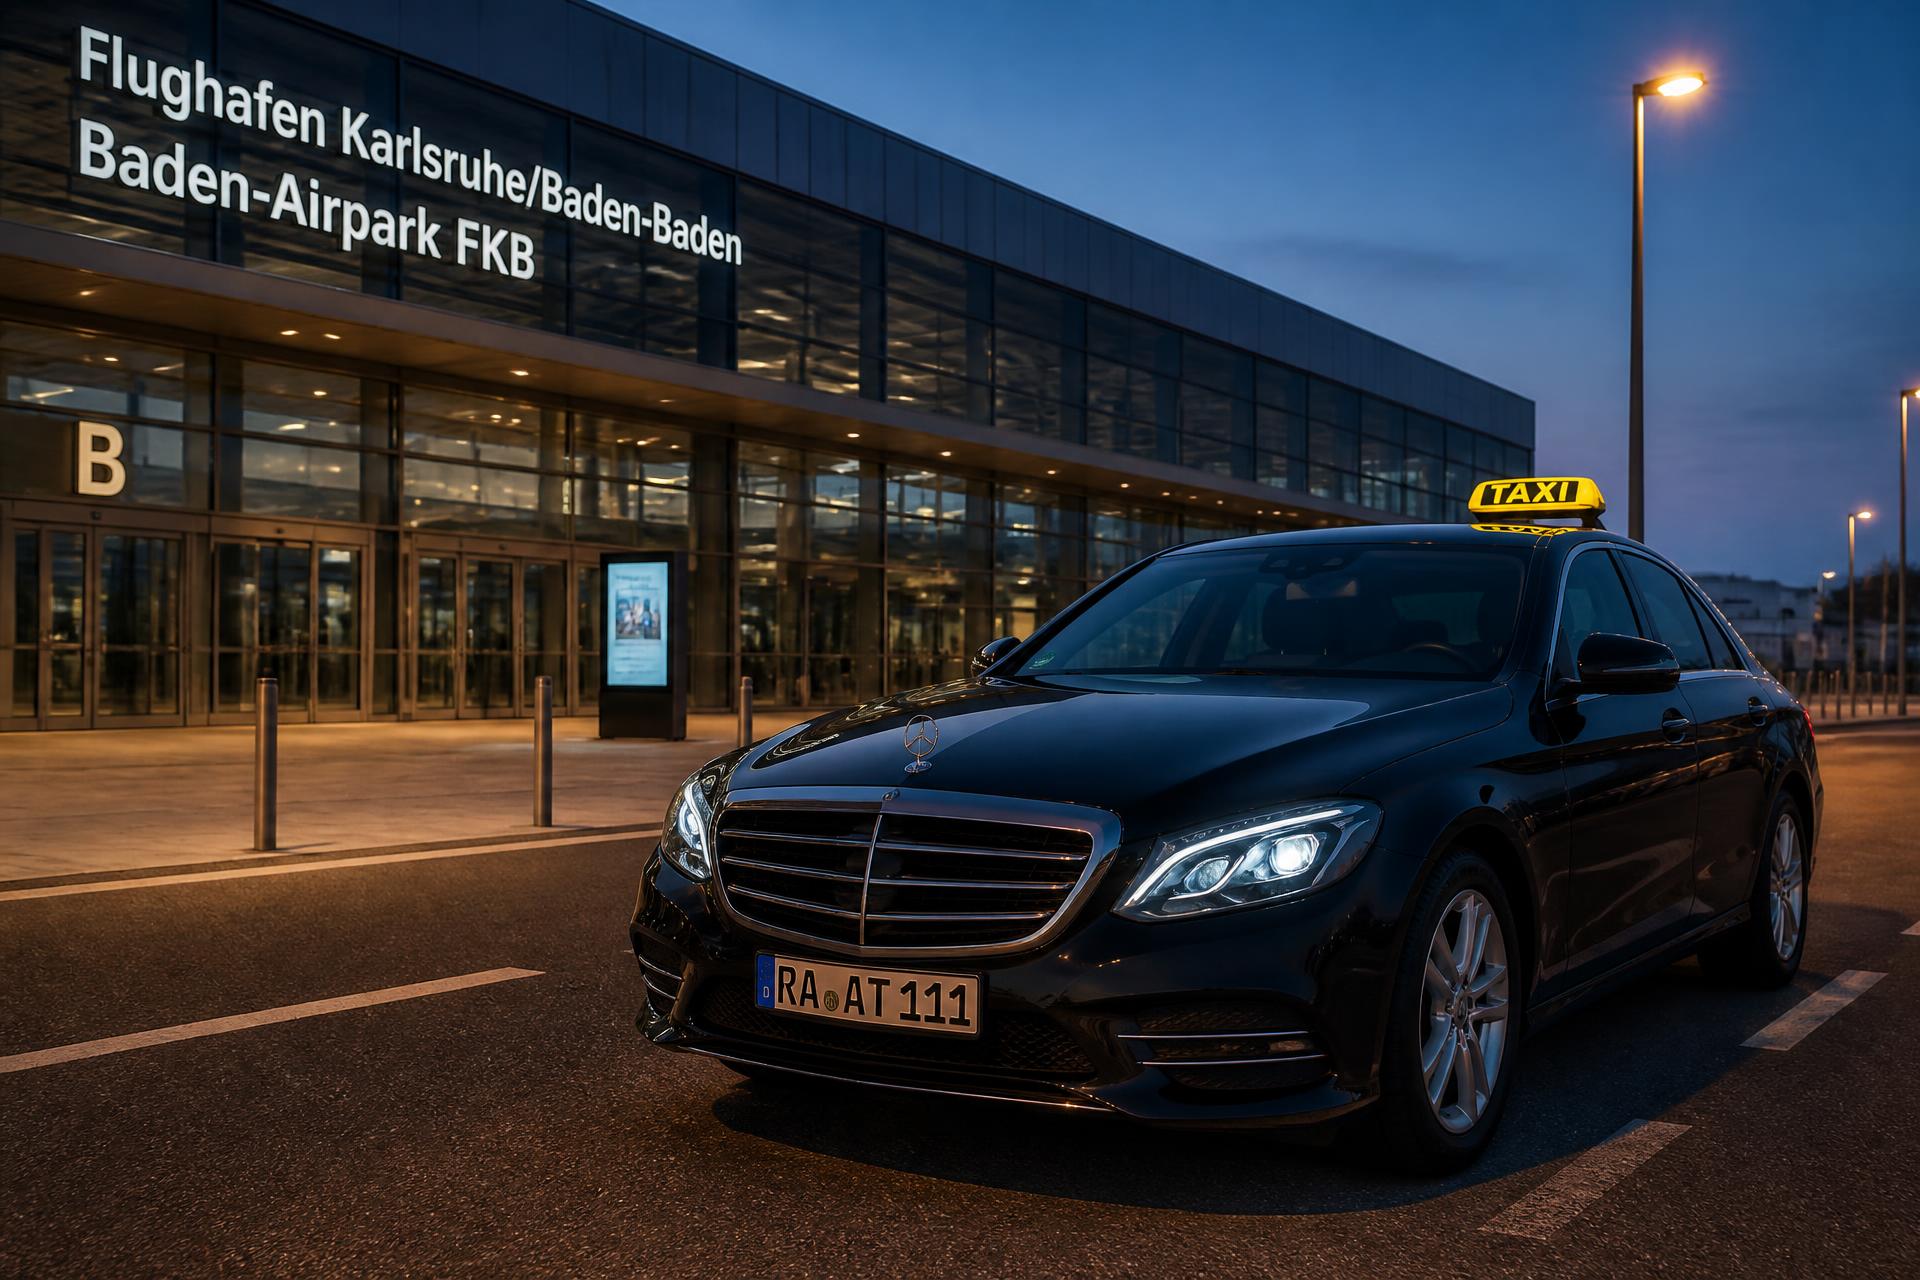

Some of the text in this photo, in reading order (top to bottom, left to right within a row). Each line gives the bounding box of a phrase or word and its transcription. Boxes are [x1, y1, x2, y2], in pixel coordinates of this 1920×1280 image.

[79, 25, 742, 266] Flughafen Karlsruhe/Baden-Baden
[79, 117, 535, 280] Baden-Airpark FKB
[76, 420, 126, 497] B
[1491, 481, 1569, 503] TAXI
[762, 986, 770, 998] D
[778, 965, 971, 1026] RA AT 111
